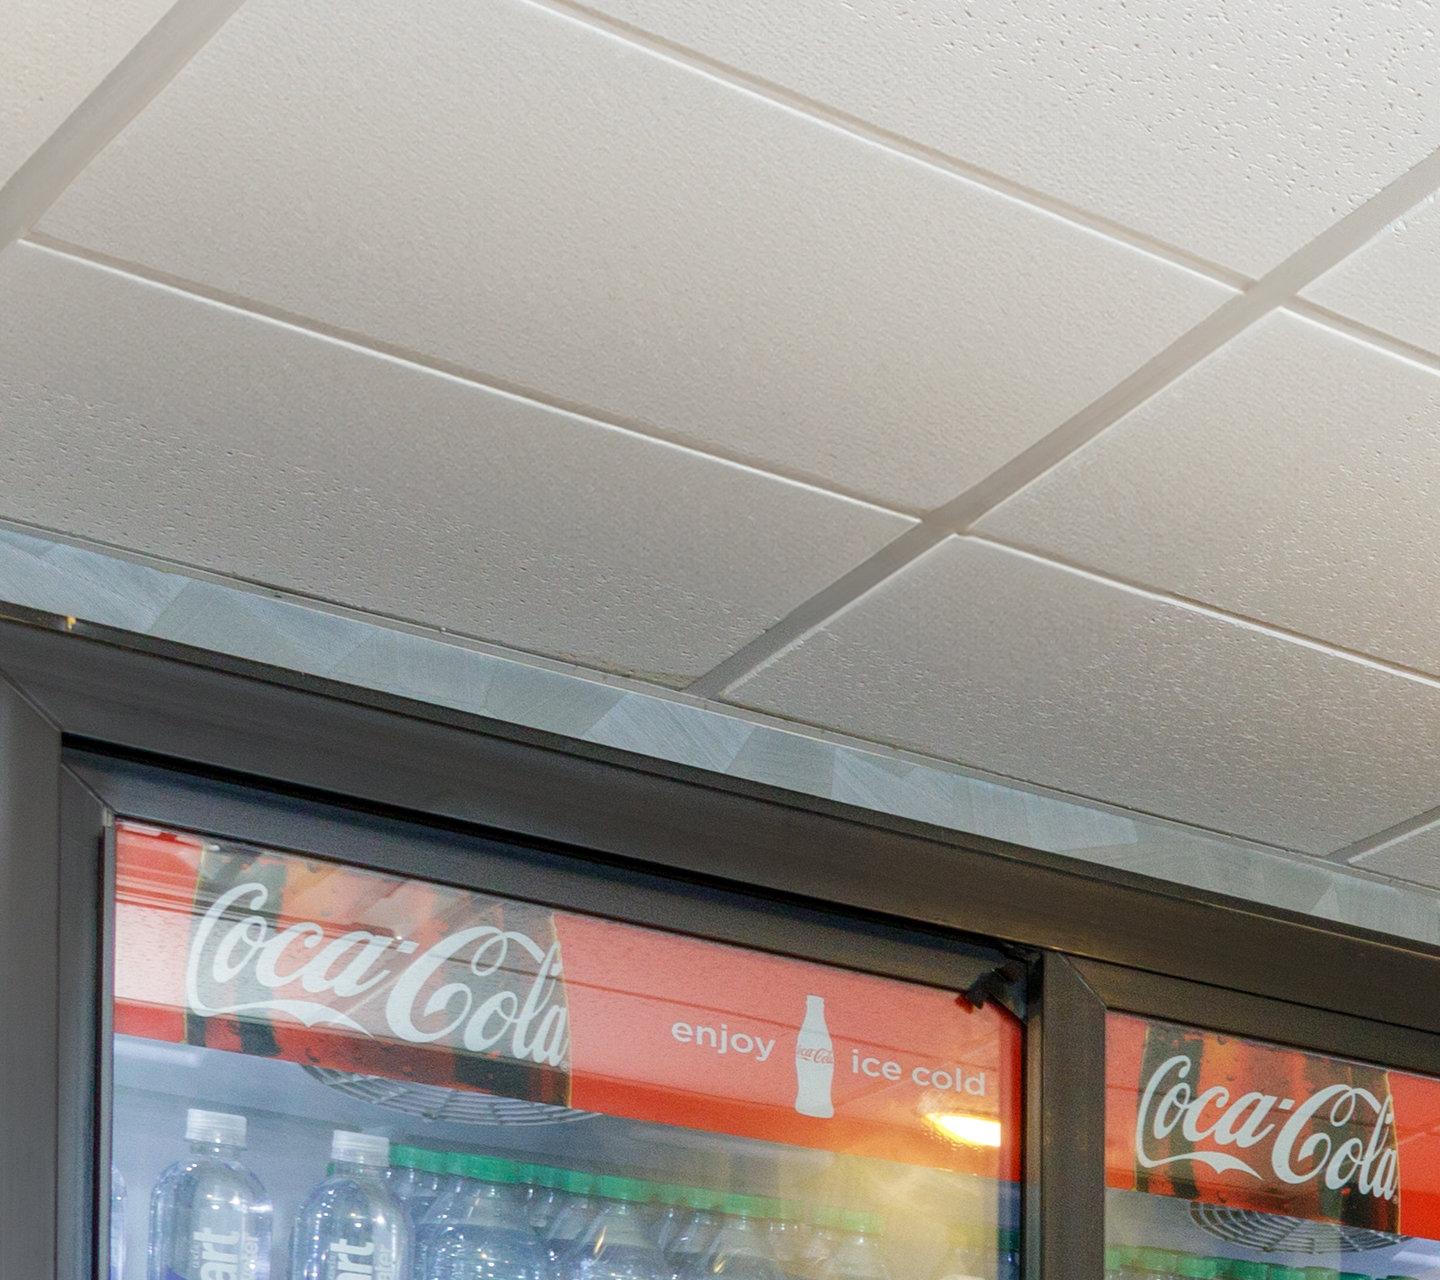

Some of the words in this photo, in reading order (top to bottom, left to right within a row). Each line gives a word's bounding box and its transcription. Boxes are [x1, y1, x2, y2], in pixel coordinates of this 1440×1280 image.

[184, 883, 569, 1069] Coca-Cola
[671, 1017, 776, 1063] enjoy
[852, 1049, 902, 1082] ice
[911, 1061, 986, 1097] cold
[1137, 1054, 1399, 1203] Coca-Cola
